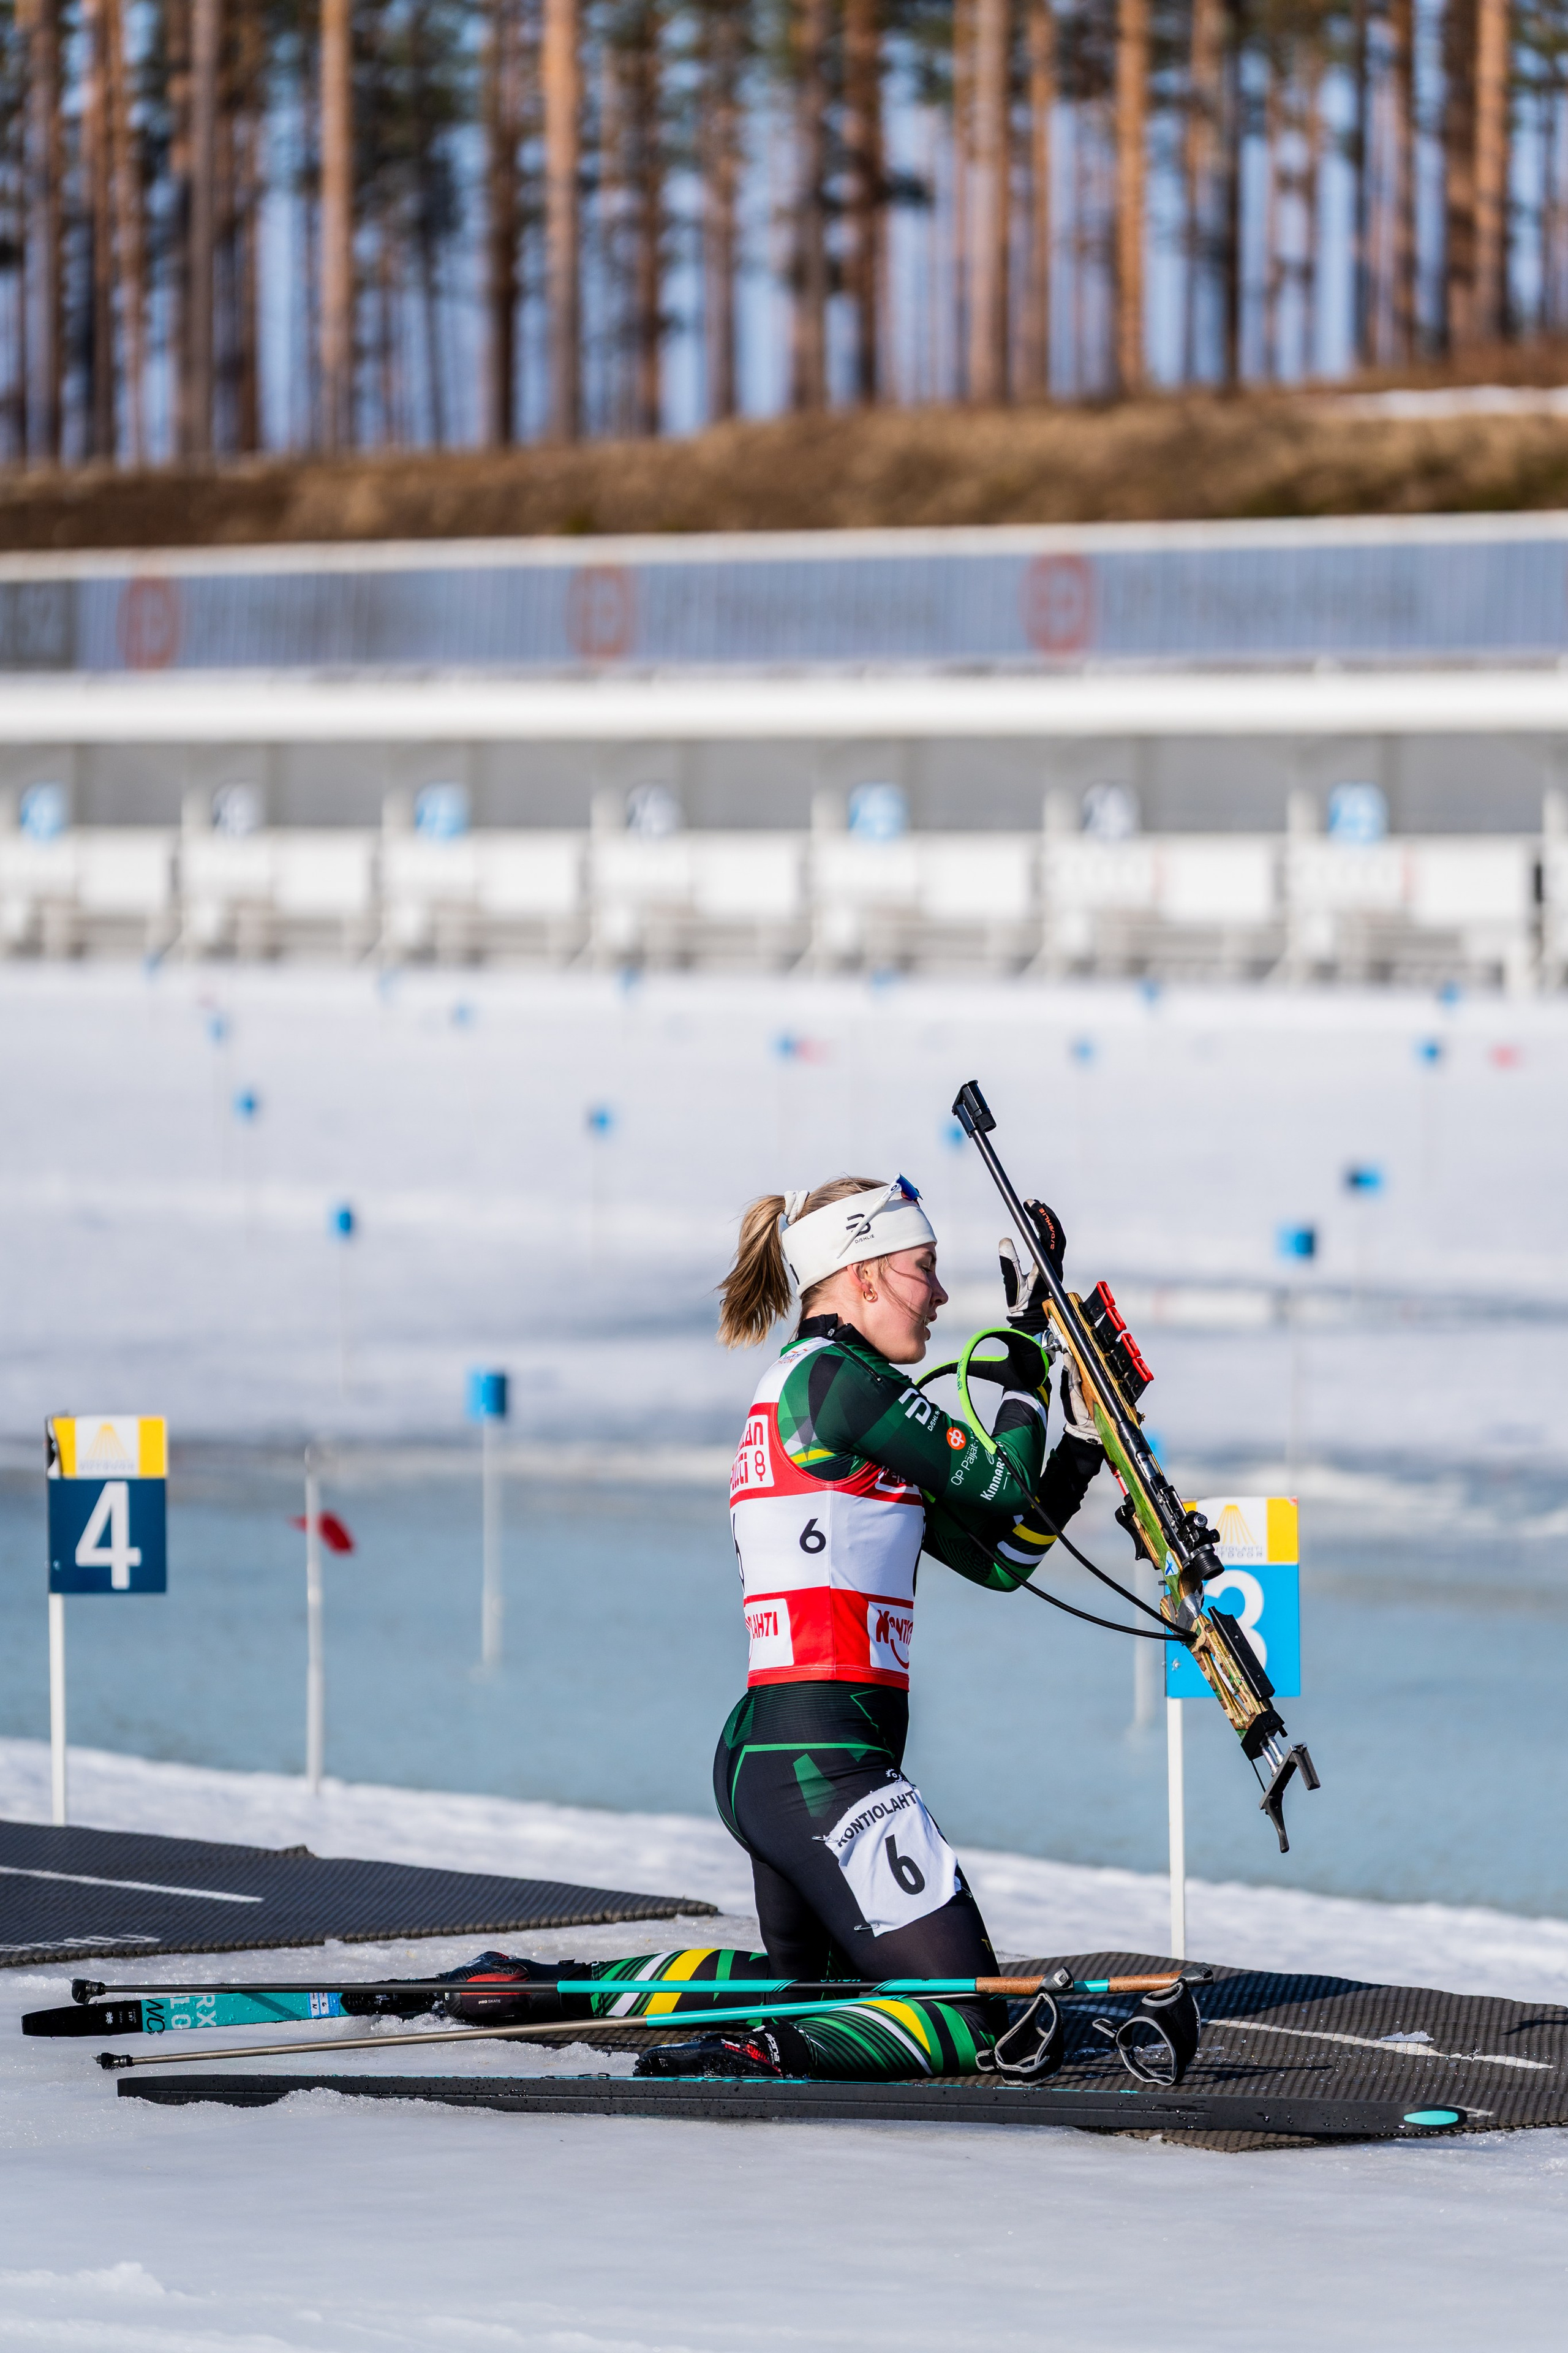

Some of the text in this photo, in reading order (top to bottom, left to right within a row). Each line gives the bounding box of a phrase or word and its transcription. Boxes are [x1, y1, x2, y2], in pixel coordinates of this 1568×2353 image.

[951, 1469, 965, 1486] OP
[75, 1480, 142, 1590] 4
[799, 1517, 827, 1555] 6
[1204, 1569, 1268, 1674] 3
[884, 1834, 925, 1896] 6
[195, 1994, 217, 2028] RX
[764, 2033, 780, 2063] alpina
